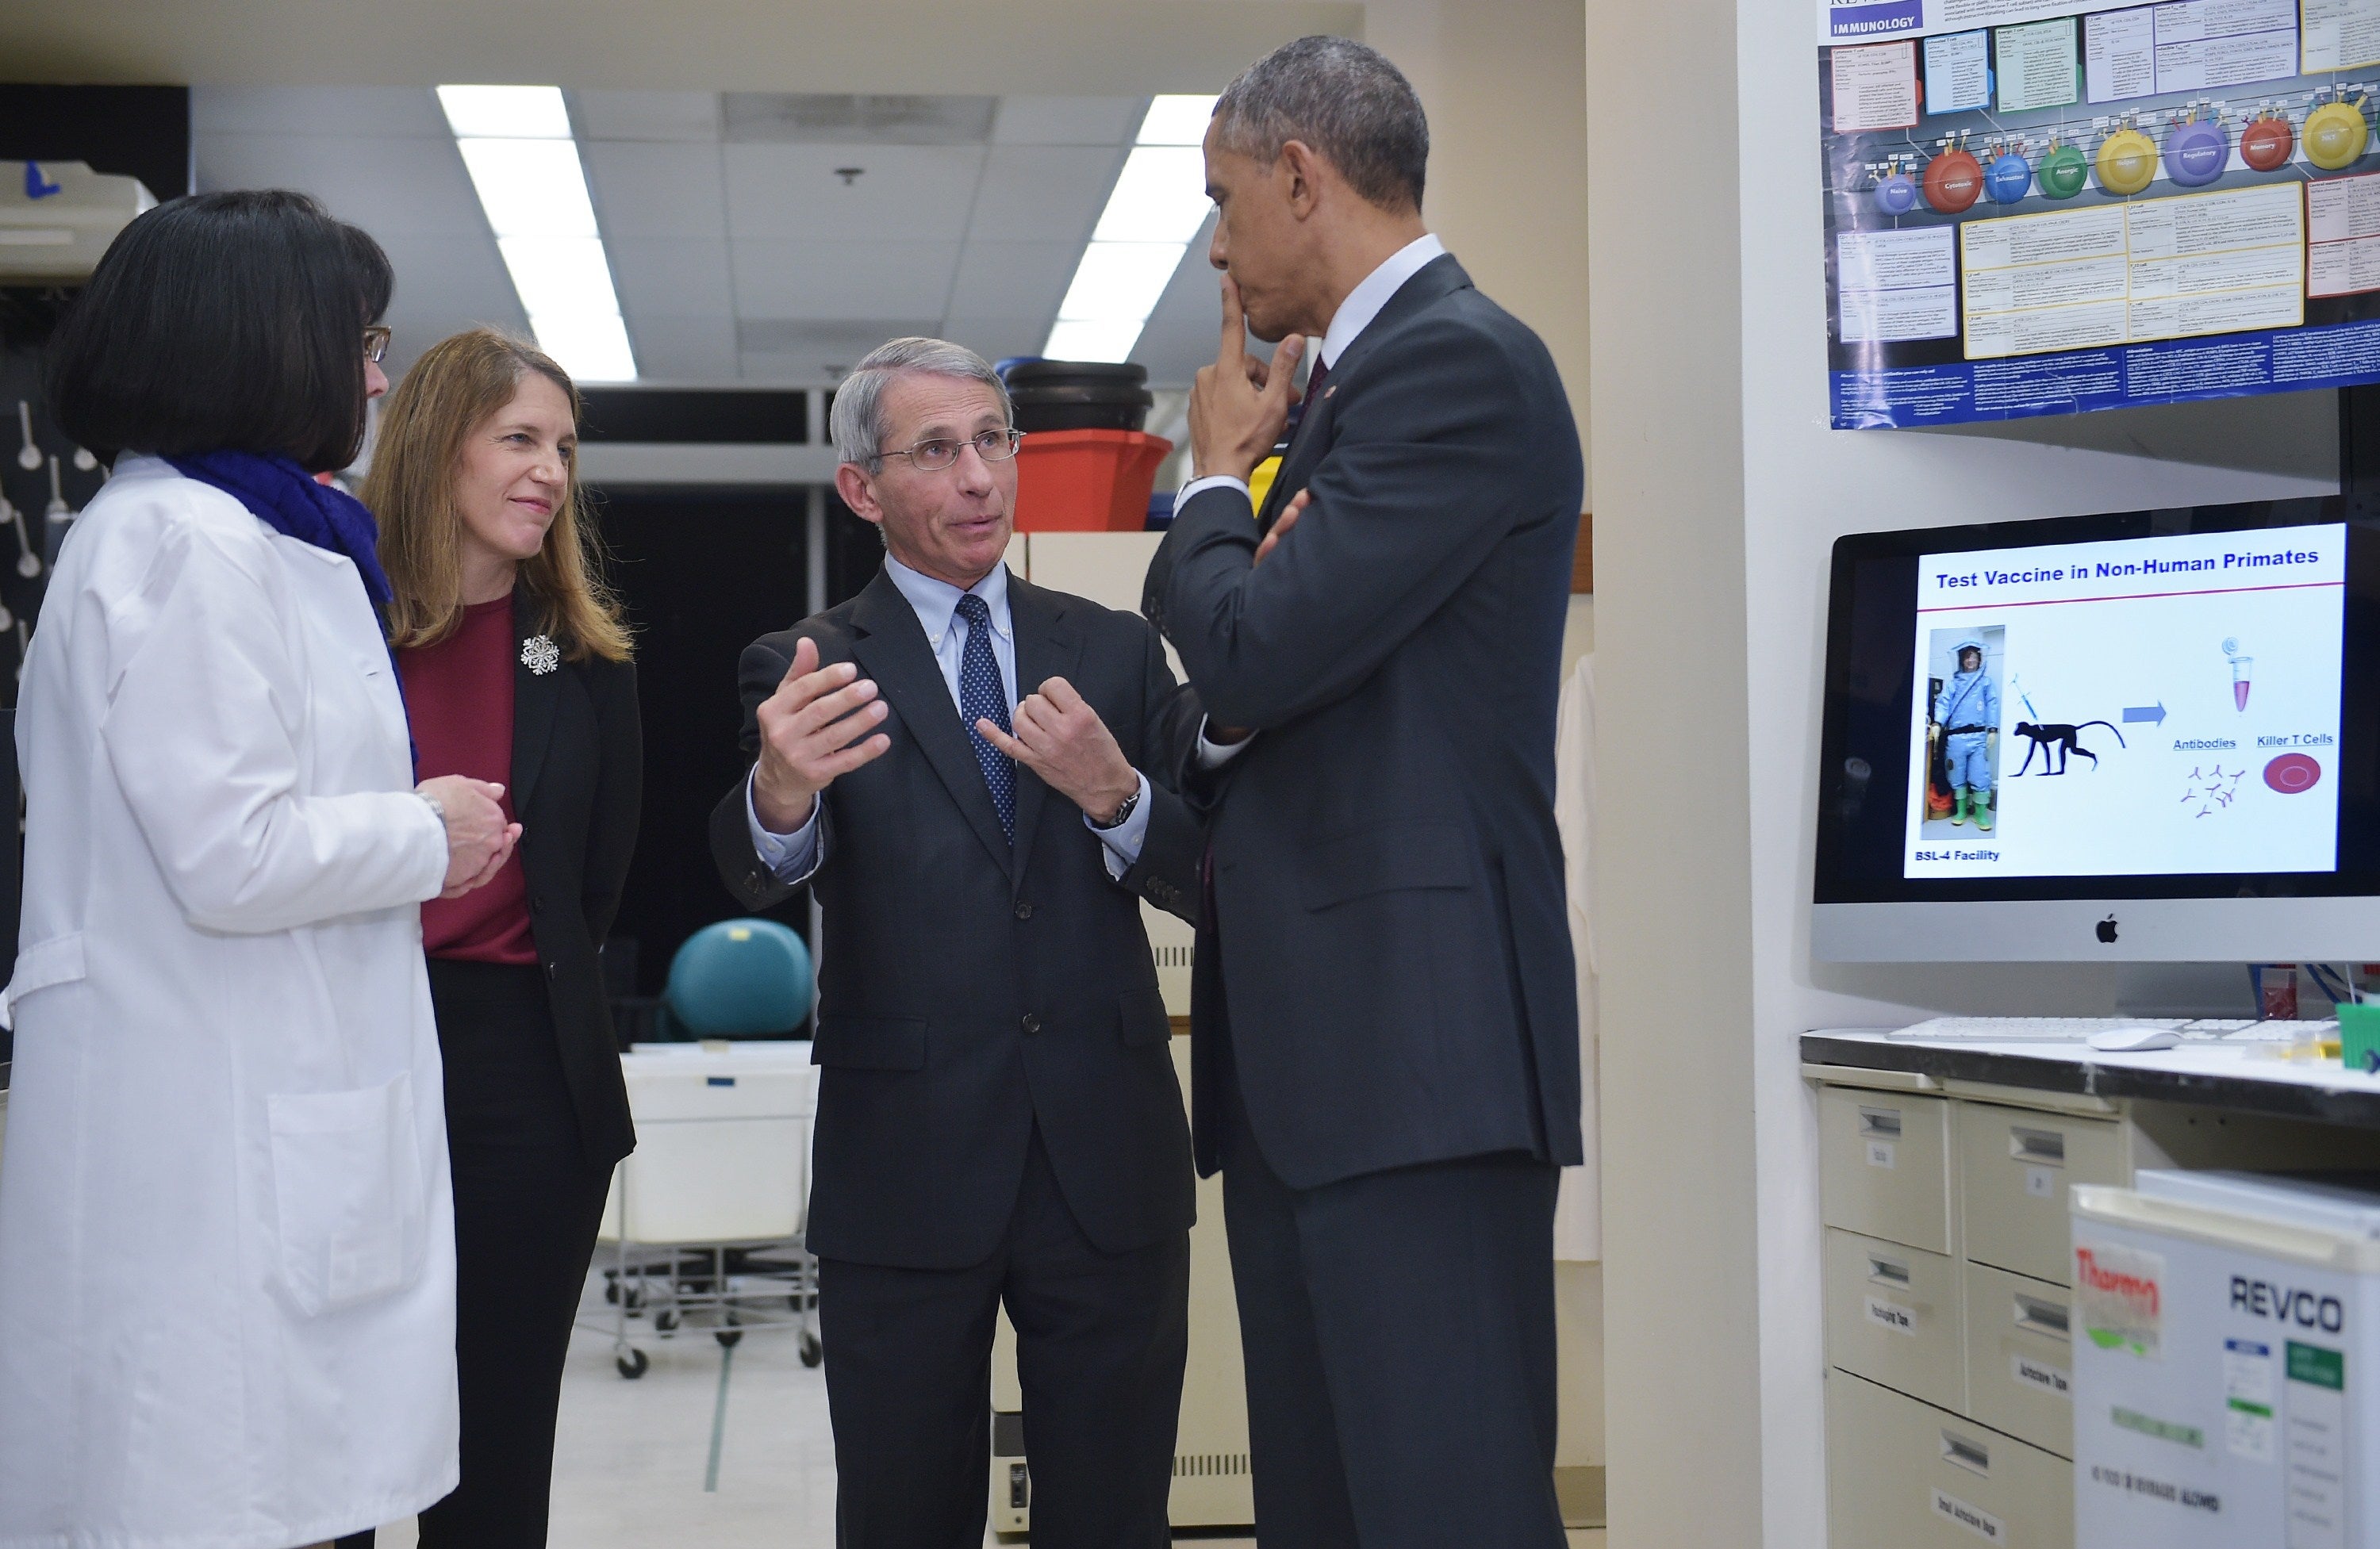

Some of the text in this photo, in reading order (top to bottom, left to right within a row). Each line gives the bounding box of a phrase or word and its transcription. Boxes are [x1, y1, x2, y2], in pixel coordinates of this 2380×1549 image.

[1834, 16, 1915, 34] IMMUNOLOGY
[2056, 167, 2079, 175] Anergic
[1996, 174, 2025, 182] Exhausted
[1944, 181, 1972, 190] Cytotoxic
[1937, 550, 2320, 589] Test Vaccine in Non-Human Primates
[2173, 738, 2236, 750] Antibodies
[2257, 733, 2333, 746] Killer T Cells
[1915, 850, 1999, 862] BSL-4 Facility
[2231, 1275, 2343, 1335] REVCO
